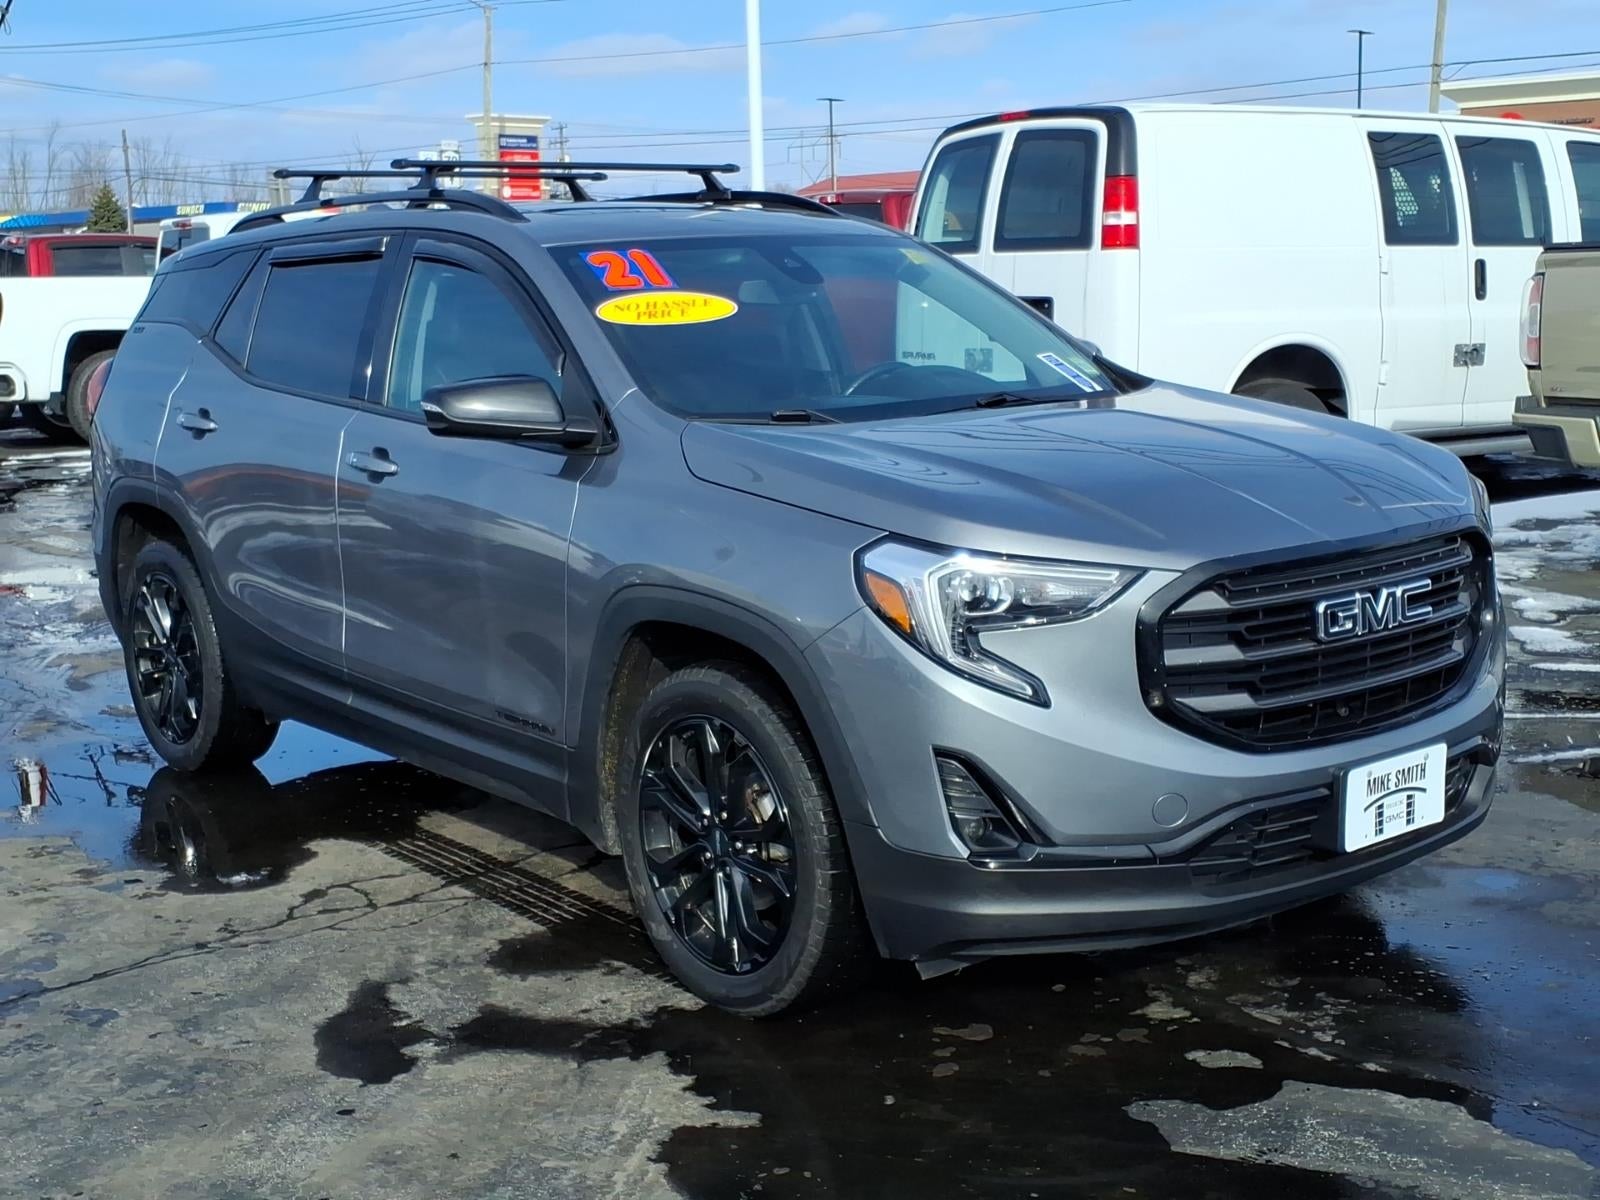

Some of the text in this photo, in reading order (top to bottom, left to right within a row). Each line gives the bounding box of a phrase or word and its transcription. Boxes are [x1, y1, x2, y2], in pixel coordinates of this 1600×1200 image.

[176, 204, 205, 216] SUNOCO
[586, 249, 673, 288] 21
[614, 298, 712, 312] NO HASSLE
[636, 308, 689, 321] PRICE
[1315, 578, 1433, 641] GMC
[1366, 761, 1427, 798] MIKE SMITH
[1385, 811, 1405, 824] GMC
